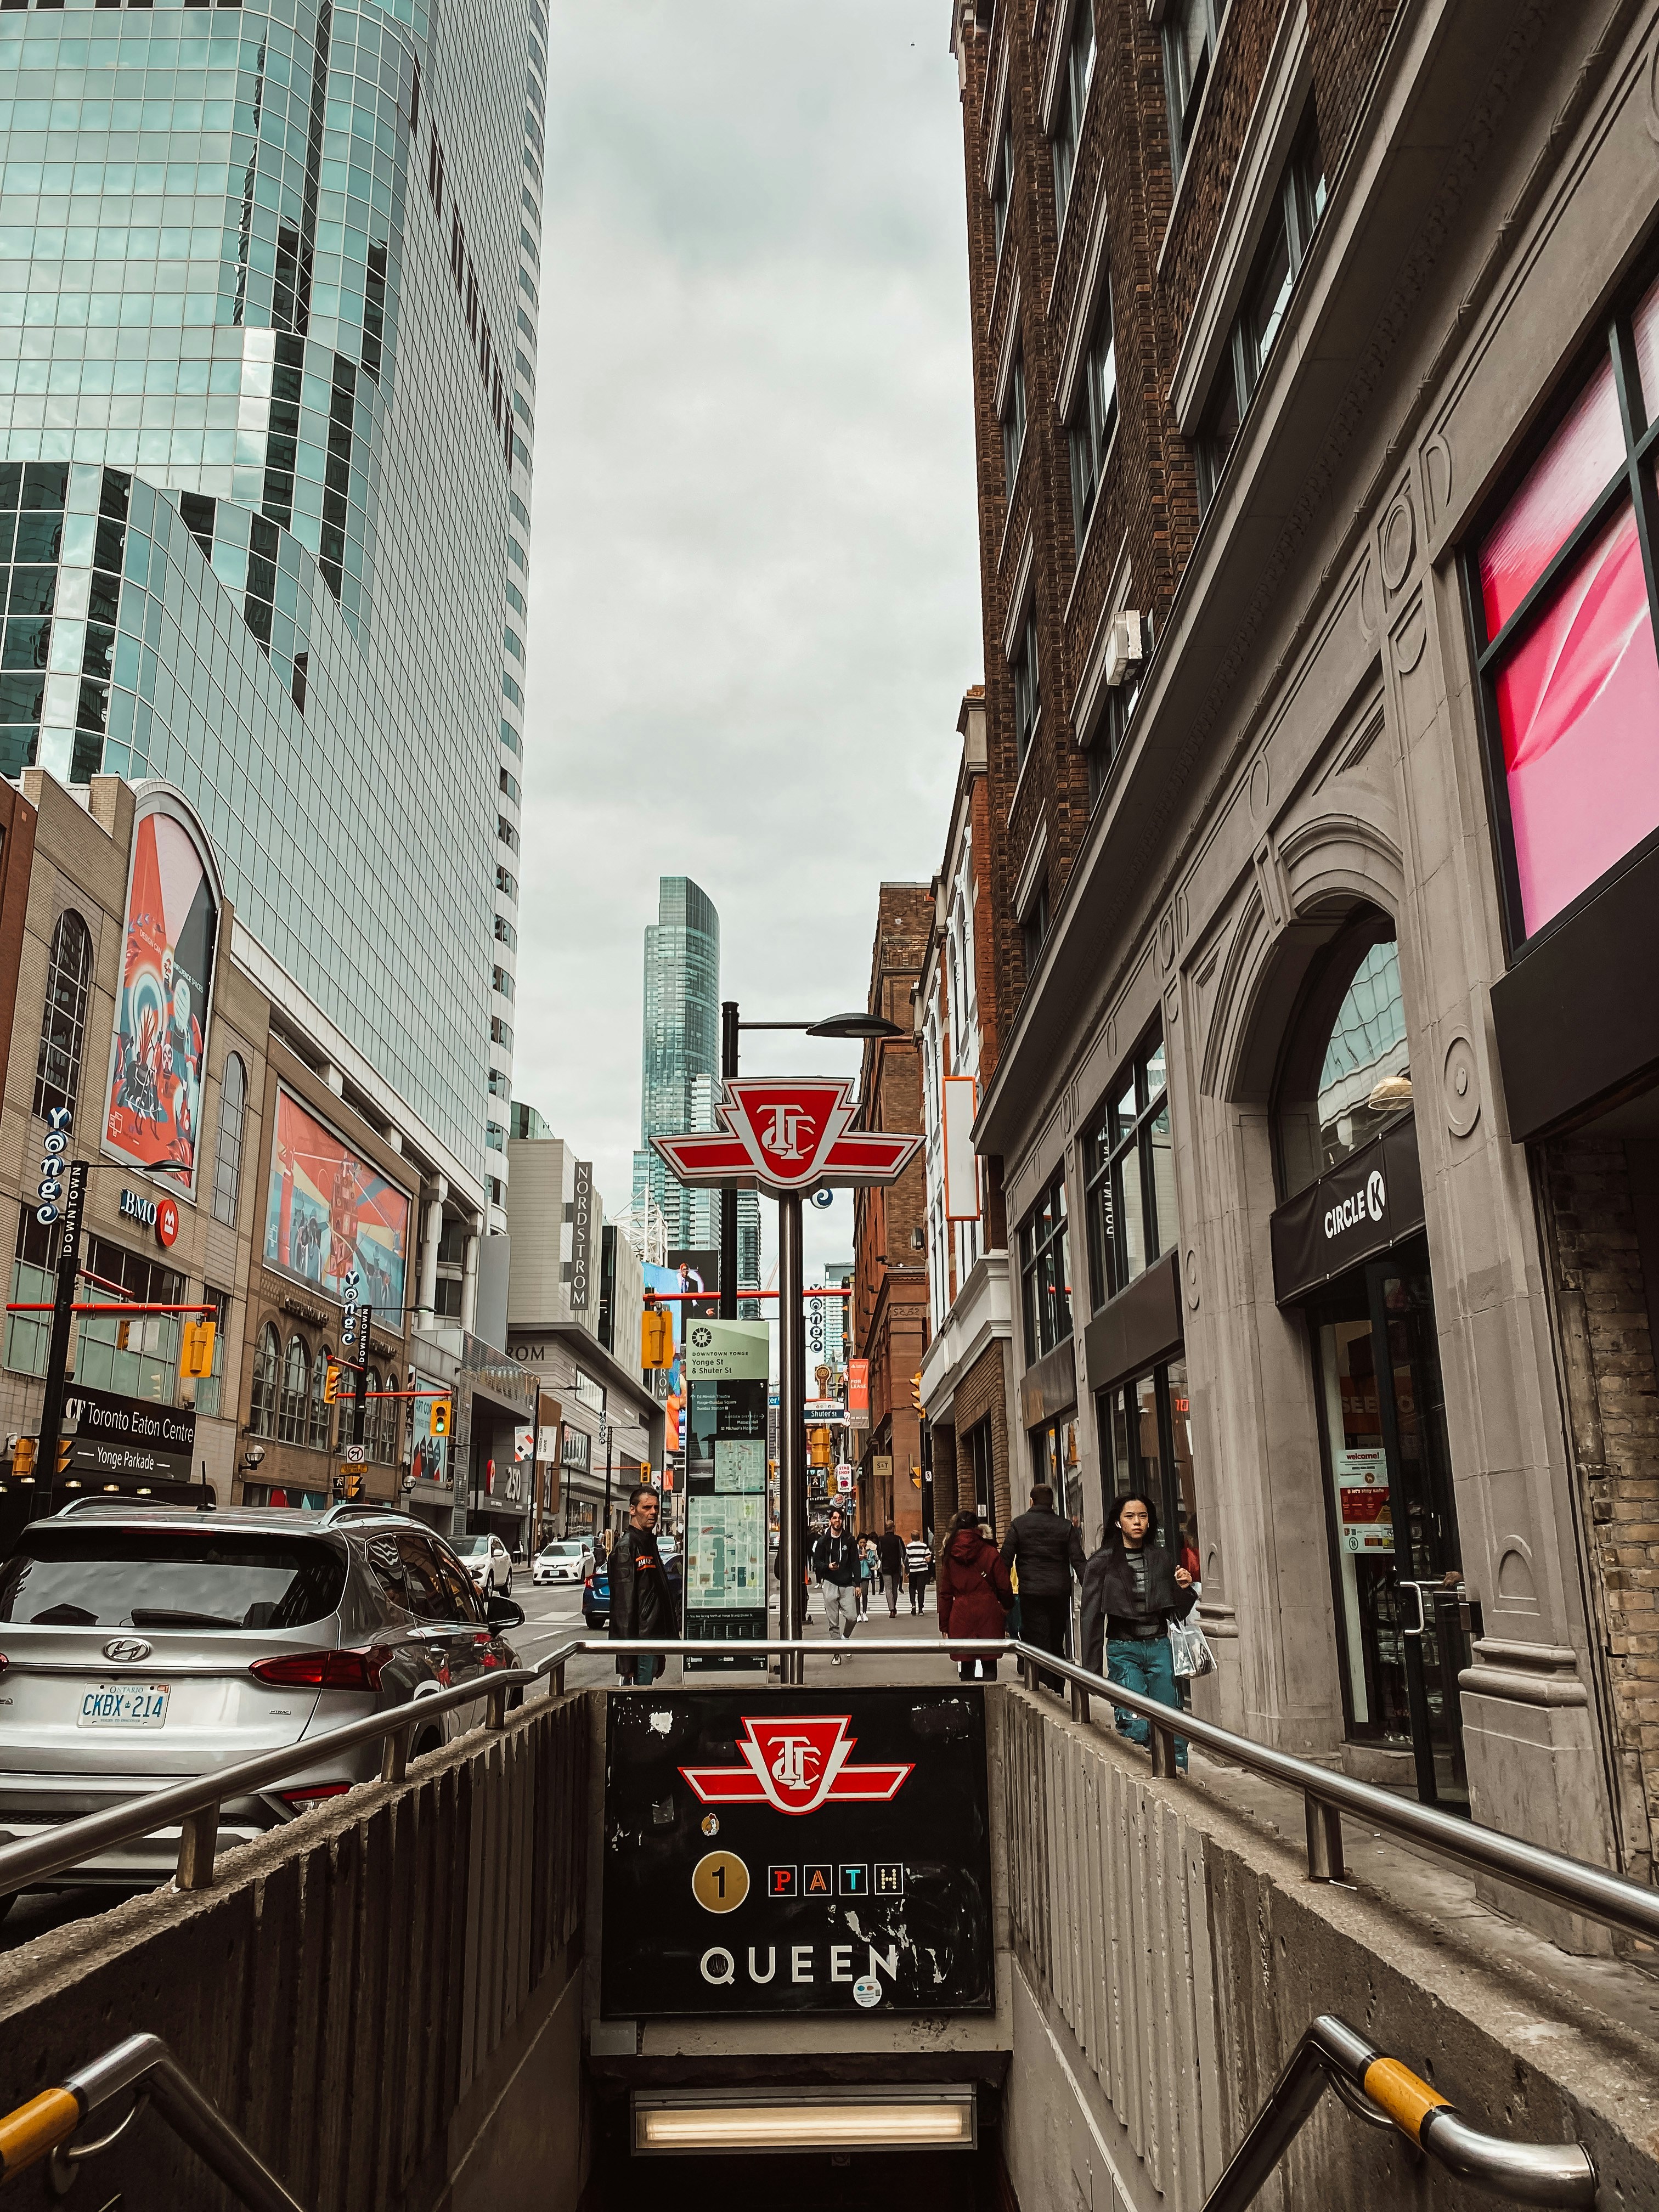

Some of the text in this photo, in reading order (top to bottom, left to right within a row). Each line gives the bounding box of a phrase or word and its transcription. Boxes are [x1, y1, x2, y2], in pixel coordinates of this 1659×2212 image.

[140, 928, 162, 955] DESIGN CAN
[191, 977, 204, 994] SPACES
[63, 1167, 81, 1254] DOWNTOWN
[125, 1189, 157, 1226] BMO
[1324, 1172, 1385, 1239] CIRCLE K
[573, 1166, 589, 1305] NORDSTROM
[359, 1308, 369, 1362] DOWNTOWN
[88, 1402, 129, 1431] Toronto
[132, 1412, 160, 1437] Eaton
[163, 1418, 194, 1443] Centre
[97, 1447, 154, 1470] Yonge Parkade
[505, 1466, 521, 1500] 250
[83, 1694, 163, 1717] CKBX 214
[712, 1865, 726, 1898] 1
[774, 1867, 897, 1891] PATH
[700, 1944, 898, 1985] QUEEN
